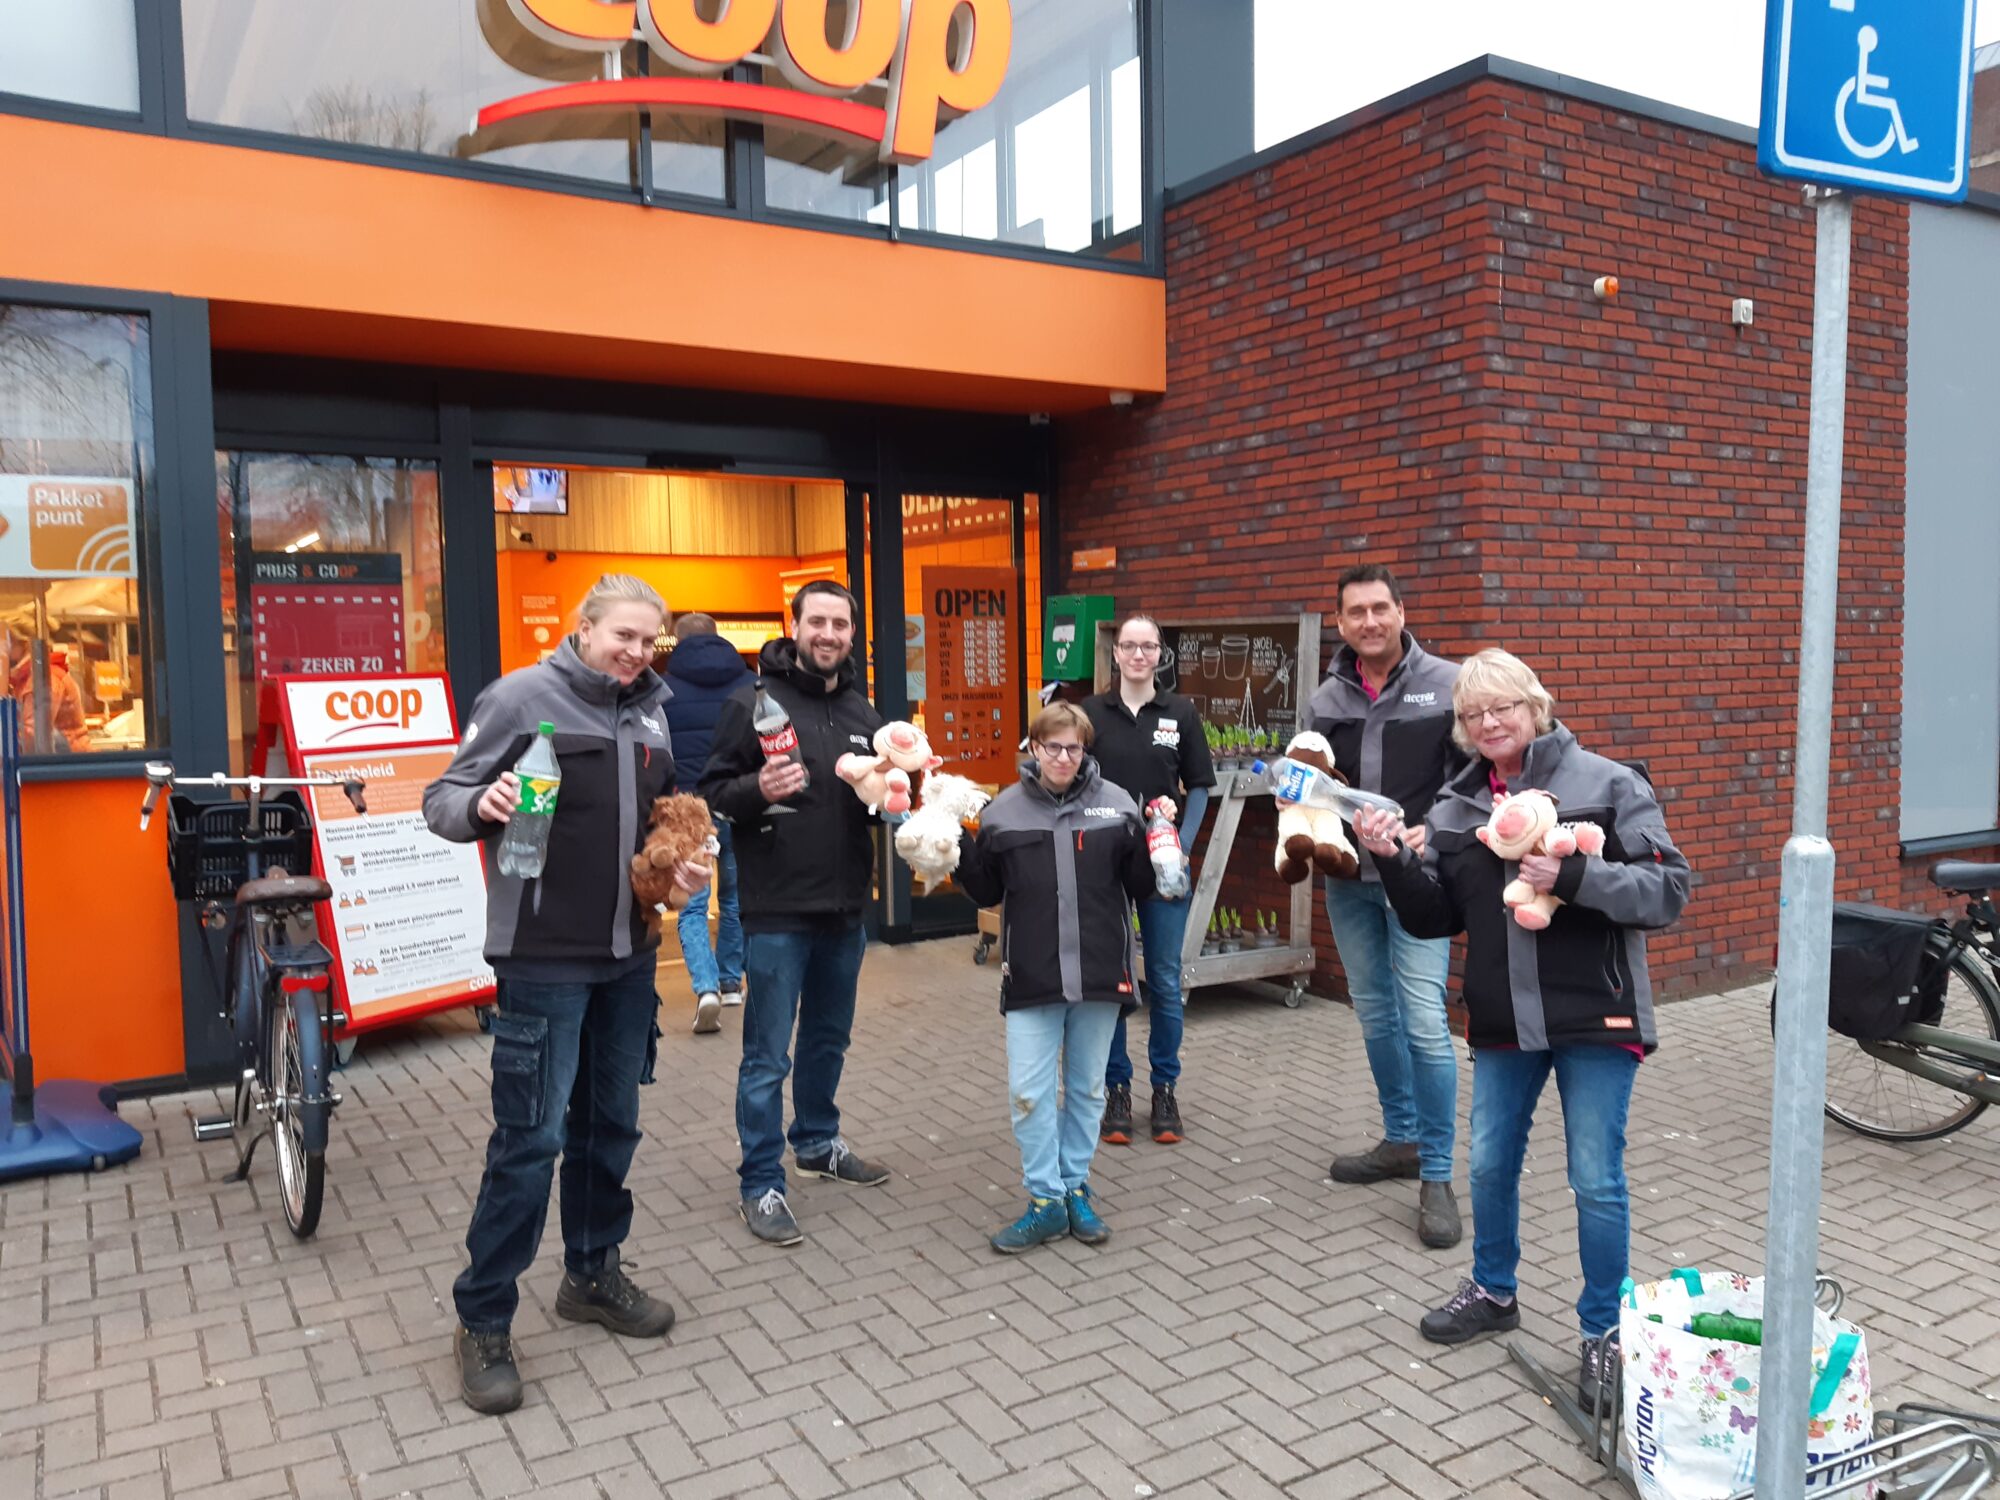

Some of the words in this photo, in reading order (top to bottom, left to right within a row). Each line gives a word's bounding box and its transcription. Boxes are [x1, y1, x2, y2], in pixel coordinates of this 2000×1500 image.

[34, 487, 104, 508] Pakket
[35, 509, 85, 528] punt
[318, 563, 358, 578] COOP
[935, 588, 1006, 617] OPEN
[1178, 641, 1199, 653] GROOT
[1253, 637, 1273, 650] SNOEI
[301, 657, 355, 673] ZEKER
[361, 656, 383, 673] ZO
[325, 687, 422, 729] coop
[1289, 770, 1303, 801] rivella
[379, 947, 390, 956] Als
[1637, 1386, 1657, 1477] ACTION
